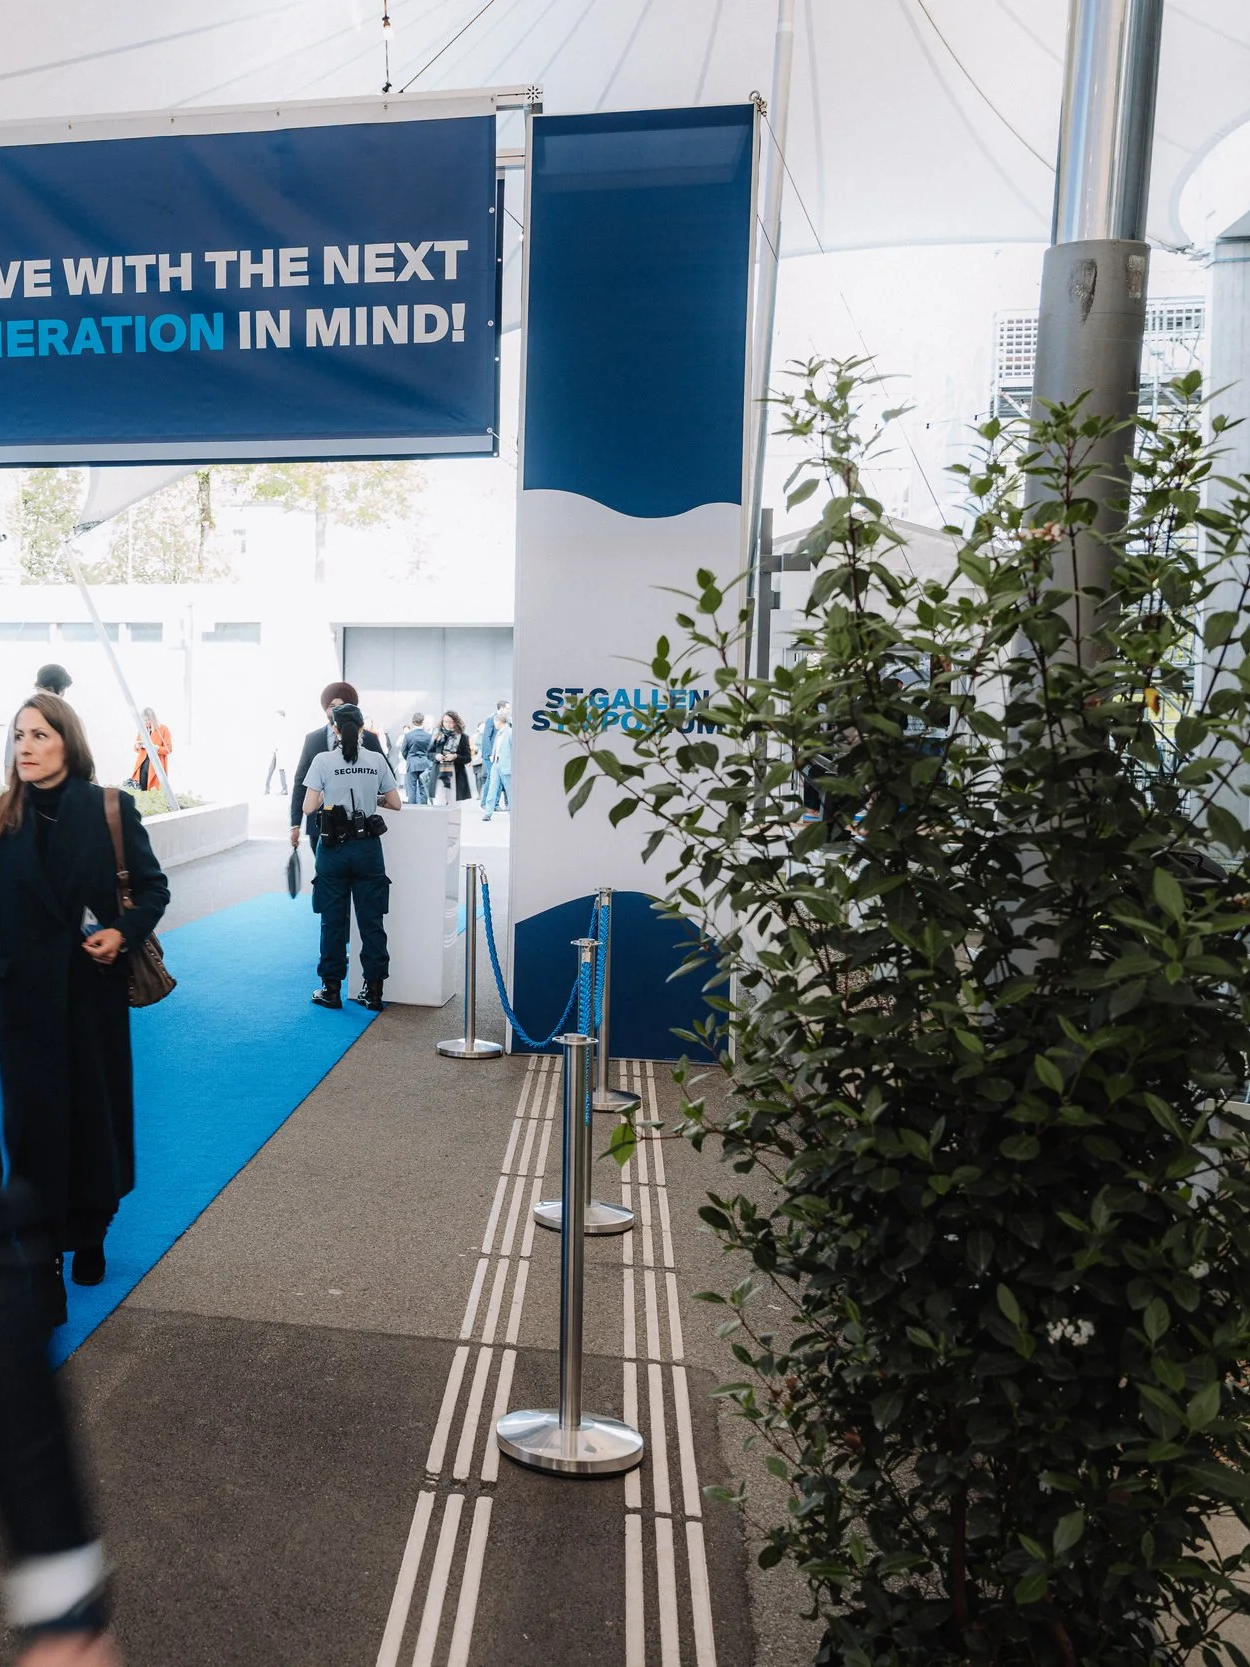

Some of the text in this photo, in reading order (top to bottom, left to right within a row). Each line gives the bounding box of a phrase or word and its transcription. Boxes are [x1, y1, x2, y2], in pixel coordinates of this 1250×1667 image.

[62, 252, 192, 296] WITH
[204, 247, 309, 290] THE
[323, 240, 468, 286] NEXT
[238, 310, 290, 350] IN
[306, 303, 466, 349] MIND!
[334, 766, 378, 776] SECURITAS
